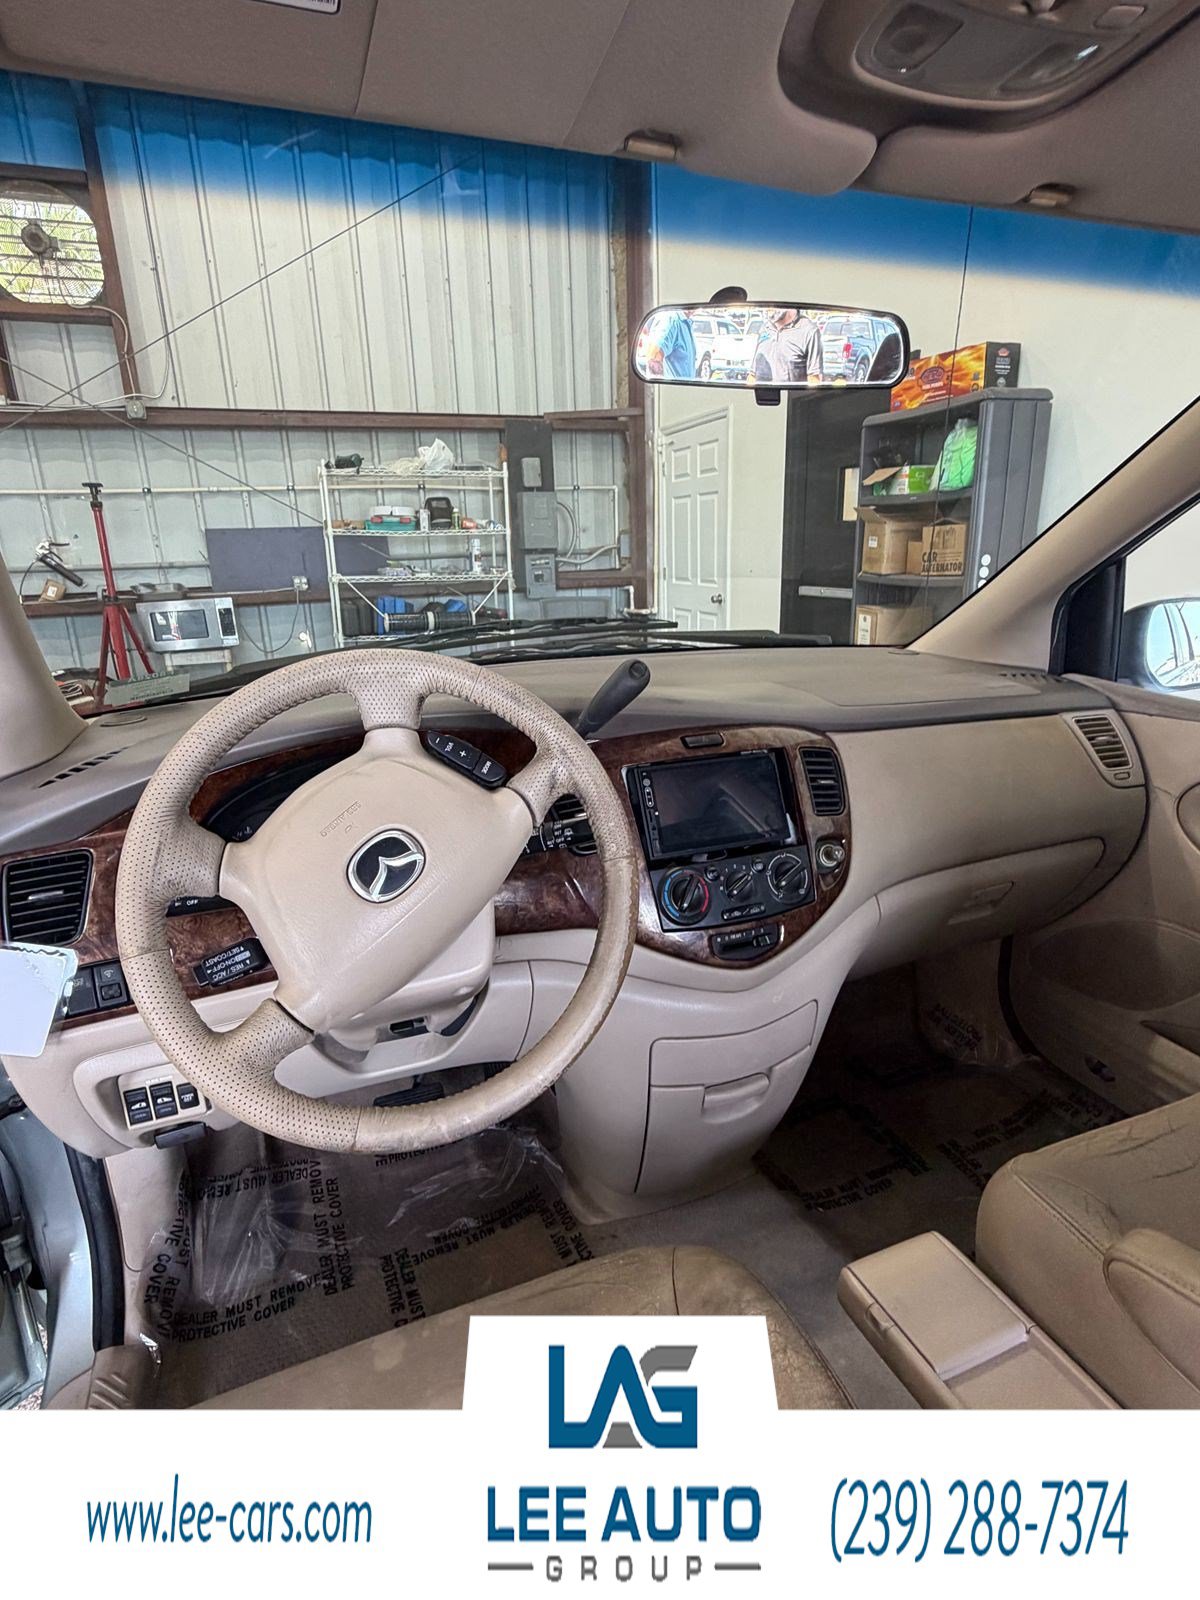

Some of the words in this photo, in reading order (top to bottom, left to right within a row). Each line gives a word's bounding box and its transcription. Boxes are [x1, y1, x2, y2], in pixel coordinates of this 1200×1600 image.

[922, 551, 938, 563] CAR
[212, 970, 226, 981] ACC
[272, 1166, 308, 1185] DEALER
[309, 1160, 325, 1204] REMOV
[326, 1177, 342, 1218] COVER
[553, 1197, 577, 1232] COVER
[313, 1213, 329, 1249] MUST
[465, 1227, 496, 1246] MUST
[332, 1222, 355, 1291] PROTECTIVE
[411, 1241, 459, 1265] REMOVE
[144, 1253, 171, 1304] COVER
[319, 1253, 338, 1296] DEALER
[174, 1310, 218, 1328] DEALER
[225, 1295, 262, 1318] MUST
[270, 1274, 321, 1302] REMOVE
[406, 1288, 426, 1320] MUST
[172, 1314, 246, 1342] PROTECTIVE
[254, 1297, 295, 1322] COVER
